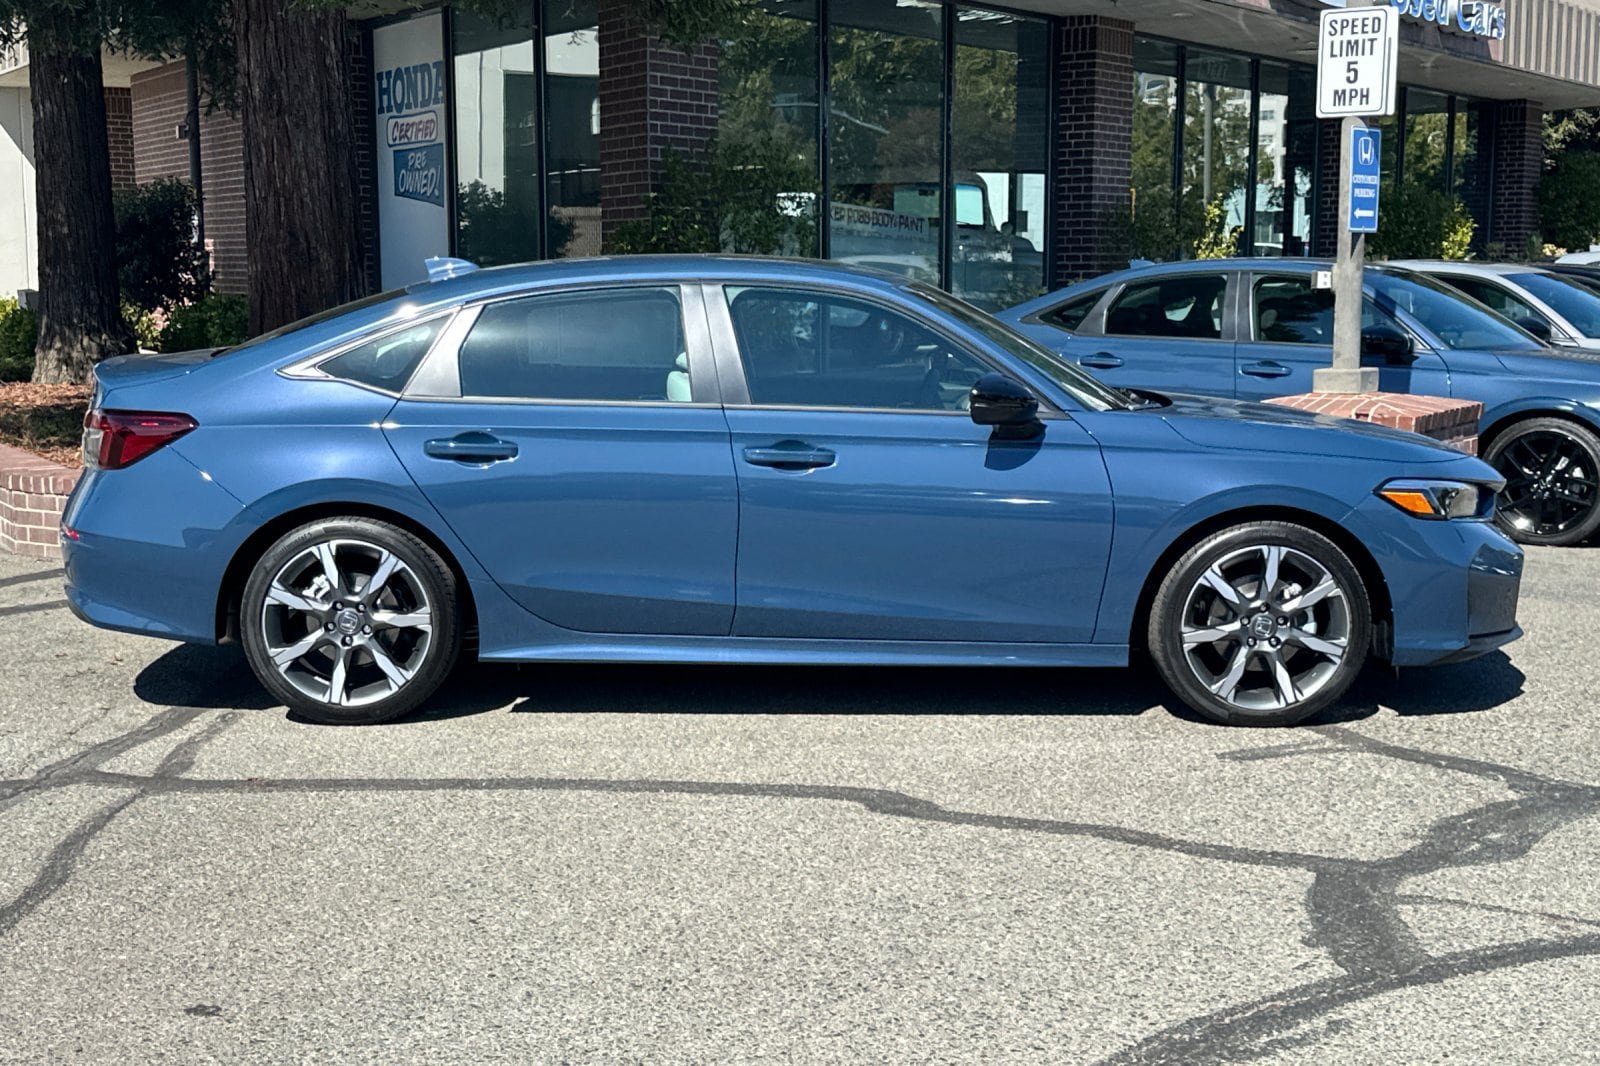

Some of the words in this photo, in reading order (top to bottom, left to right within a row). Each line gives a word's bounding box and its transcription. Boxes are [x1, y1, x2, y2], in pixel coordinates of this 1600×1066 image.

[1328, 17, 1381, 37] SPEED
[1457, 0, 1506, 40] Cars
[1329, 38, 1378, 58] LIMIT
[1345, 61, 1359, 84] 5
[376, 61, 444, 115] HONDA
[1332, 87, 1370, 107] MPH
[391, 118, 436, 142] CERTIFIED
[408, 151, 427, 170] PRE
[399, 167, 441, 197] OWNED!
[898, 215, 925, 233] PAINT
